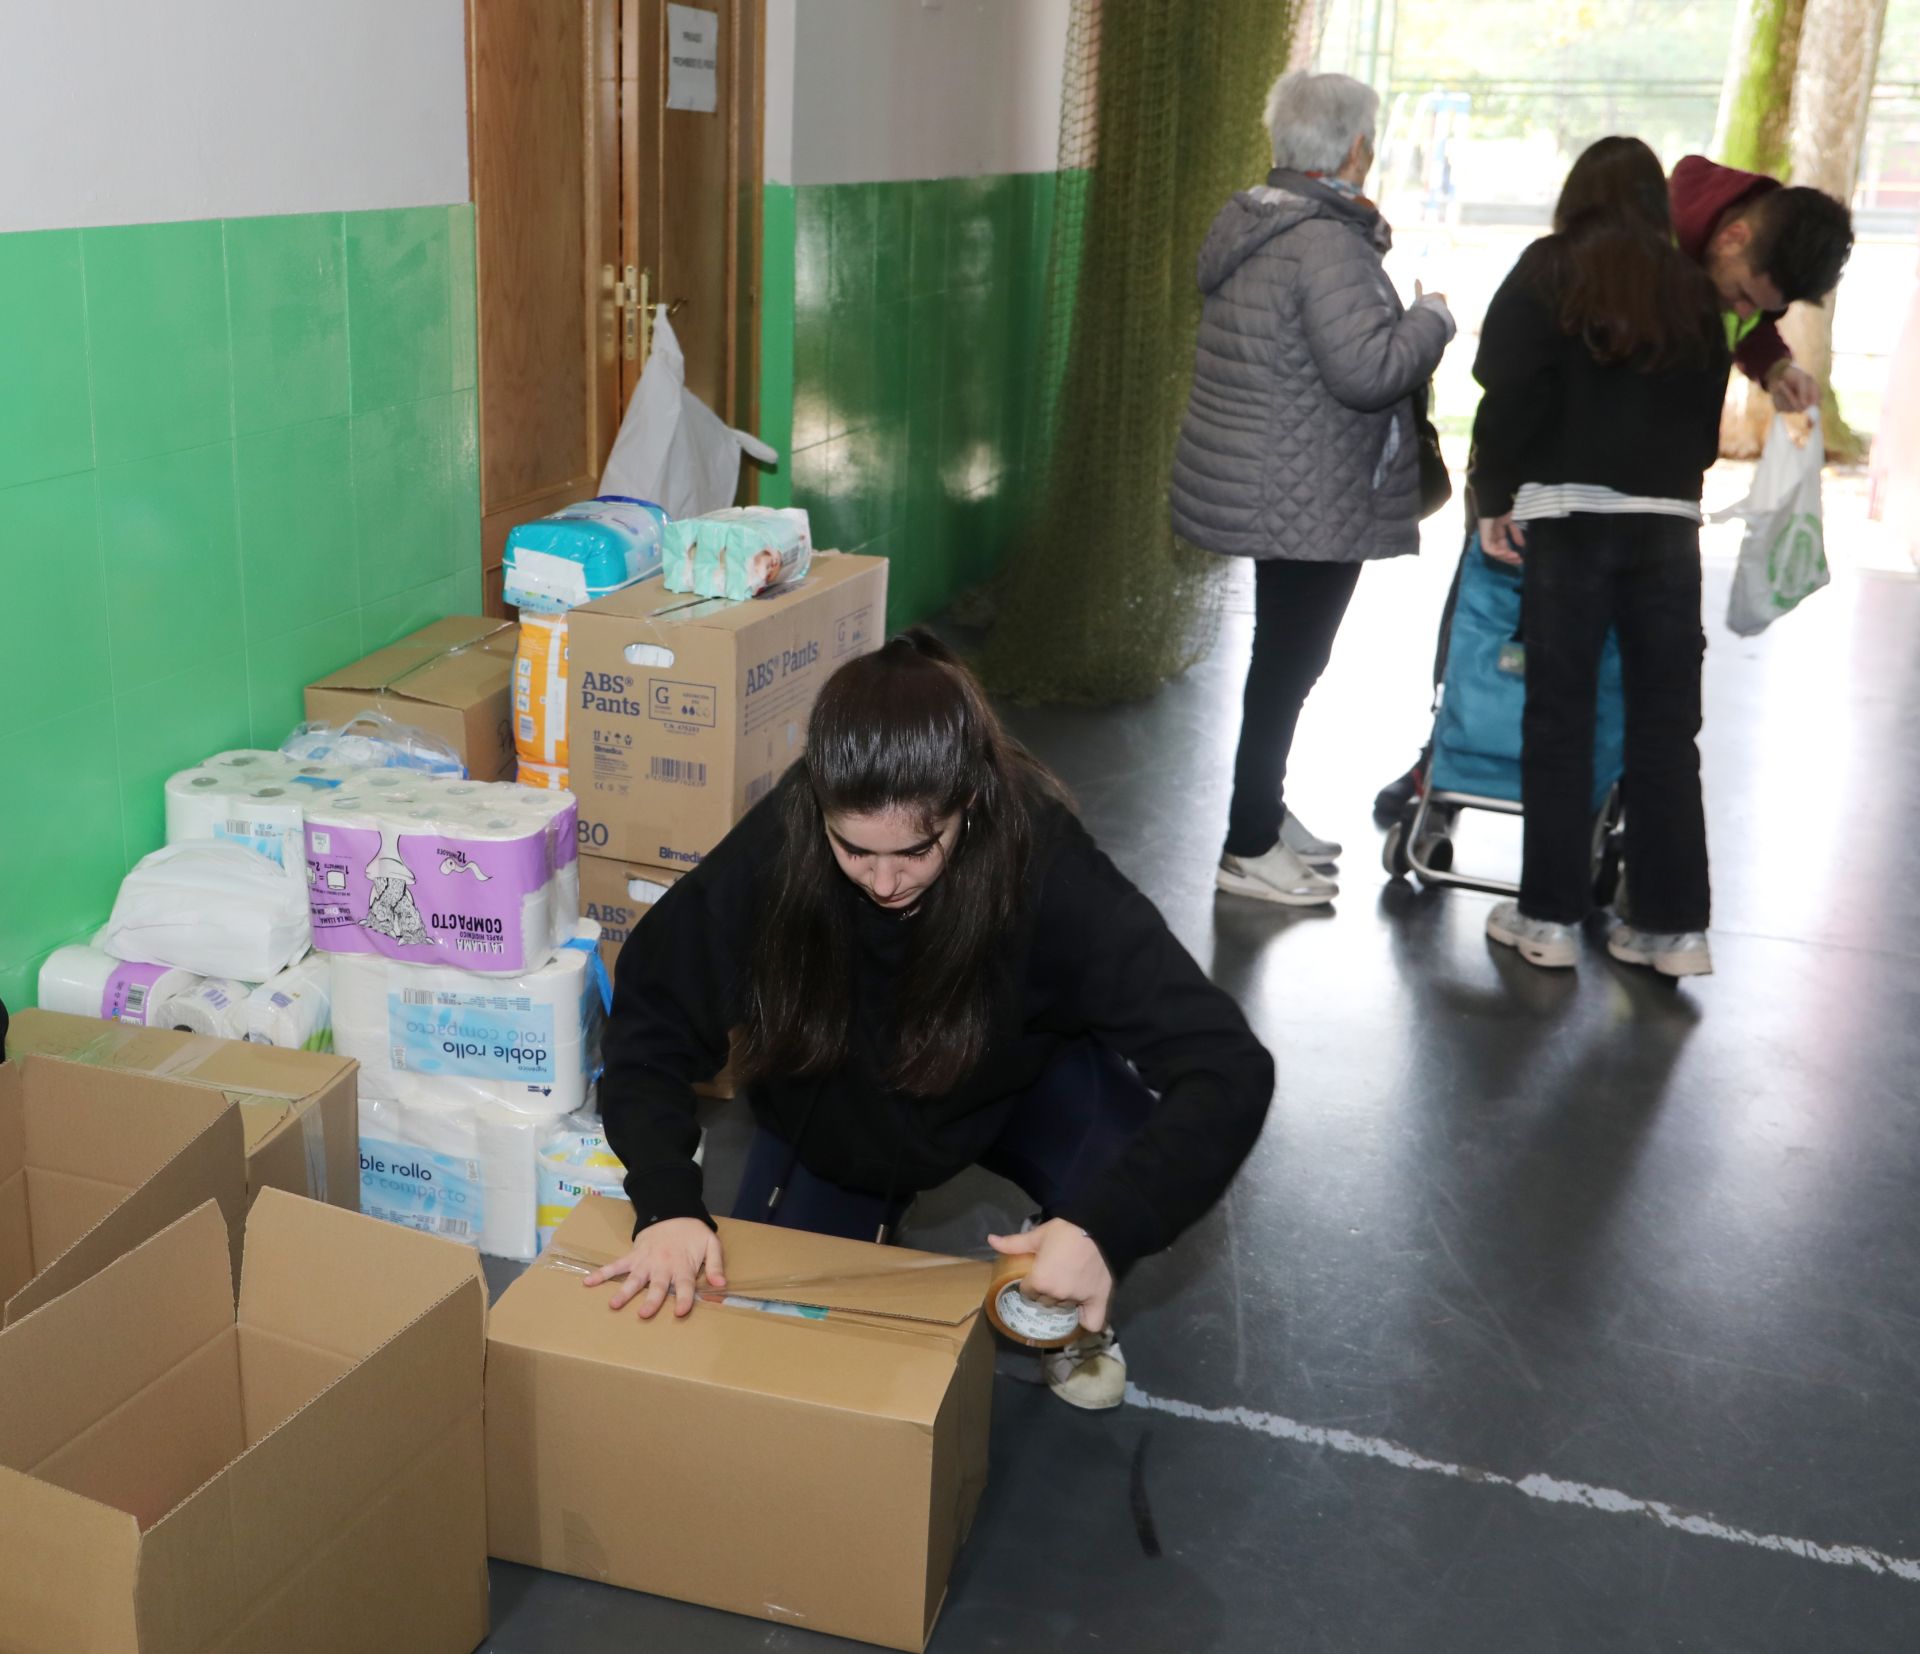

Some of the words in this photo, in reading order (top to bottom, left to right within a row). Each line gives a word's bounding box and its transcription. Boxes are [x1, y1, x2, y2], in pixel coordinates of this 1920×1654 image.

[782, 640, 819, 678] Pants
[581, 690, 641, 717] Pants
[655, 686, 670, 704] G
[577, 820, 609, 847] 80
[456, 850, 467, 864] 12
[431, 913, 503, 934] COMPACTO
[455, 938, 488, 954] LLAMA
[486, 933, 504, 942] PAPEL
[490, 942, 504, 955] LA
[406, 1020, 499, 1043] compacto
[506, 1030, 546, 1047] rolo
[442, 1041, 487, 1059] rollo
[493, 1046, 547, 1065] doble
[359, 1154, 386, 1175] ble
[391, 1162, 433, 1181] rollo
[378, 1177, 467, 1204] compacto
